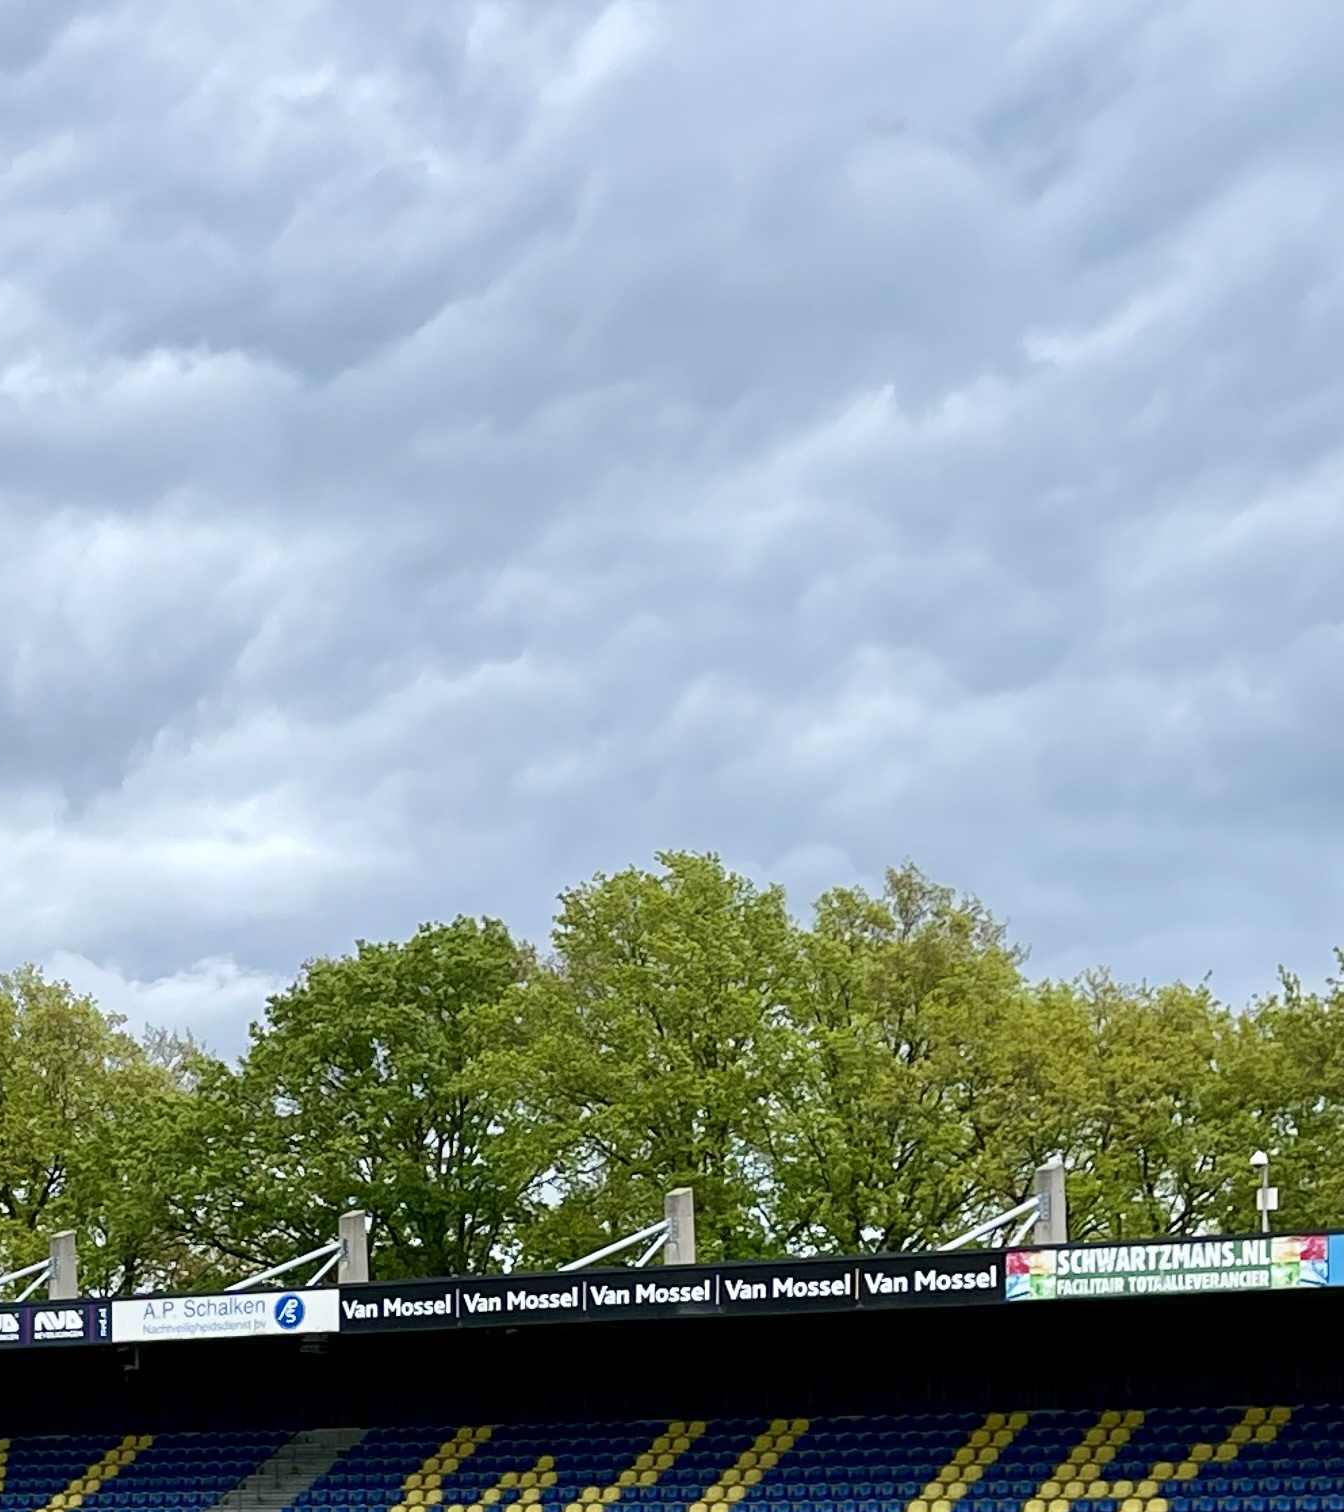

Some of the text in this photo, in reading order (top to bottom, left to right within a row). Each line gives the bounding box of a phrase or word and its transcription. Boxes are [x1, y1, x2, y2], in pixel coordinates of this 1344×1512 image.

[1056, 1239, 1271, 1275] SCHWARTZMANS.NL
[590, 1279, 711, 1306] Van Mossel
[724, 1273, 852, 1302] Van Mossel
[863, 1265, 998, 1295] Van Mossel
[1056, 1270, 1270, 1296] FACILITAIR TOTAALLEVERANCIER
[183, 1297, 266, 1318] Schalken
[341, 1293, 453, 1319] Van Mossel
[463, 1287, 580, 1314] Van Mossel
